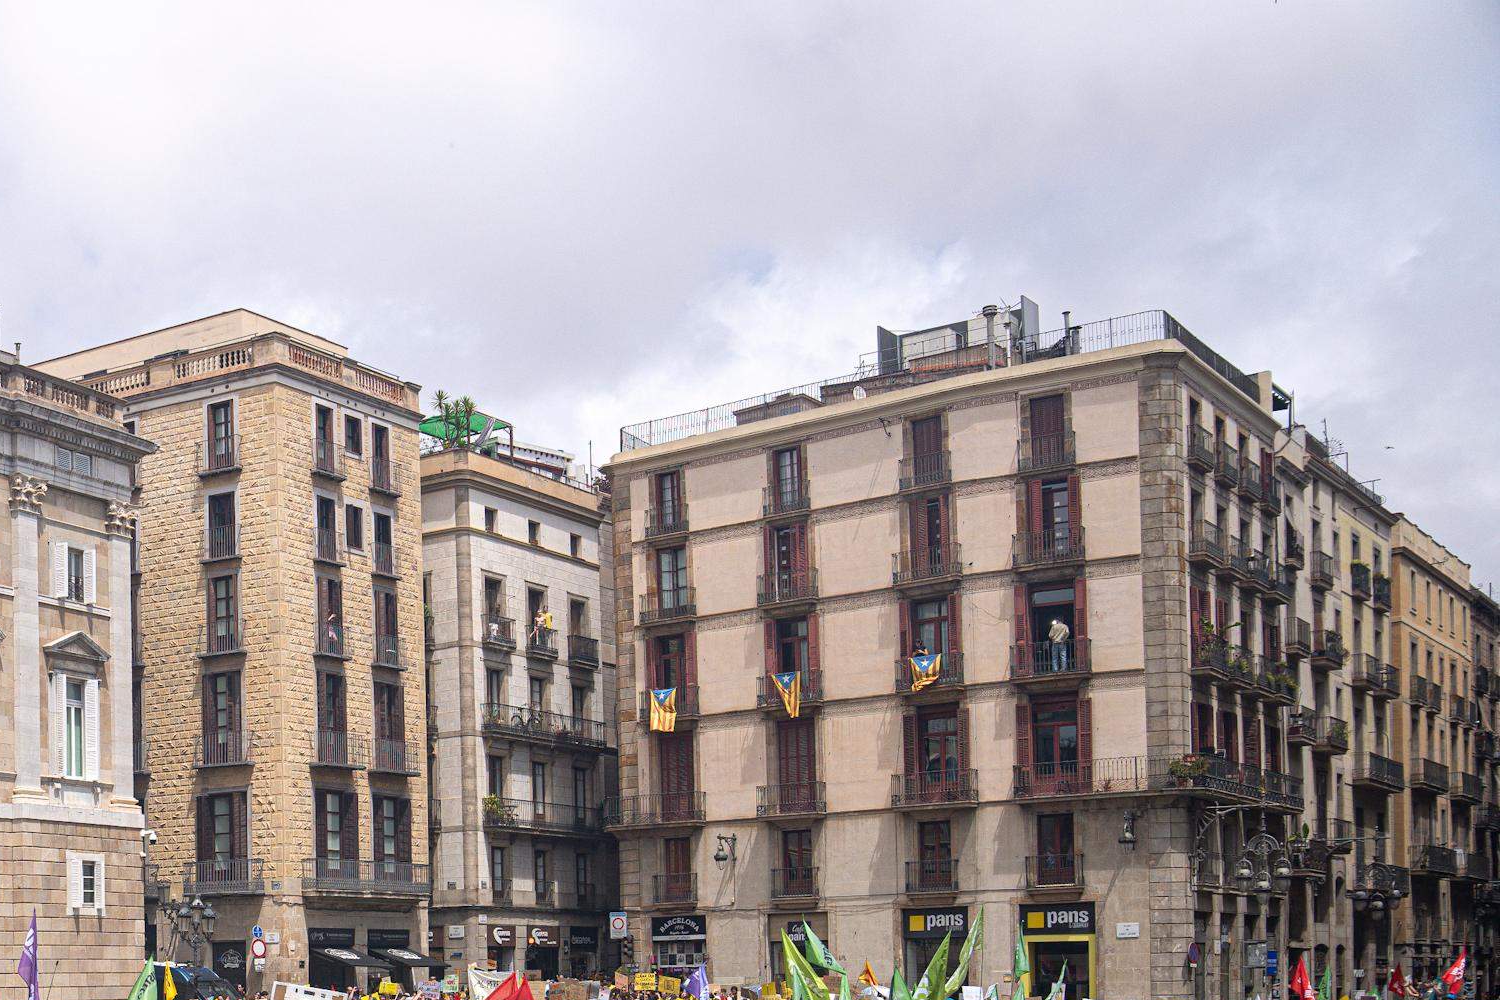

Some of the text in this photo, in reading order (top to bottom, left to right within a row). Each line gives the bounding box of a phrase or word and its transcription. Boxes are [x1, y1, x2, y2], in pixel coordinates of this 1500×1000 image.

[659, 917, 700, 933] BARCELONA
[926, 913, 964, 931] pans
[1046, 910, 1090, 929] pans
